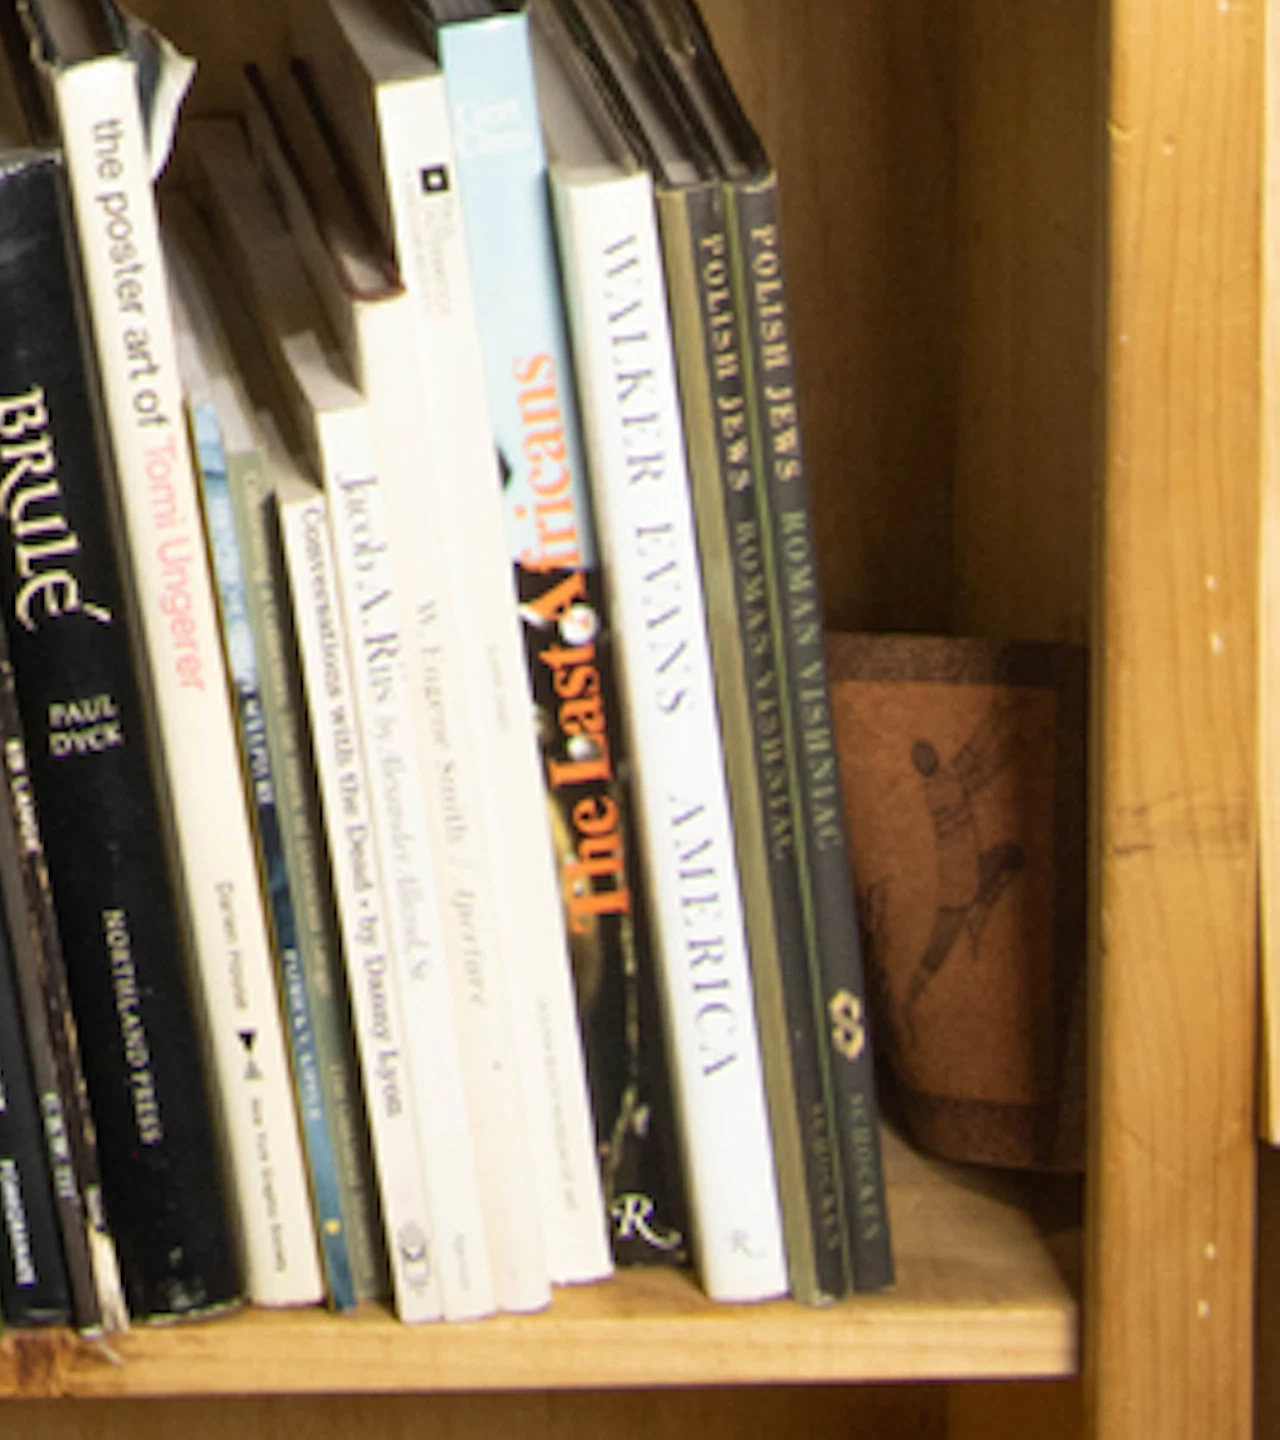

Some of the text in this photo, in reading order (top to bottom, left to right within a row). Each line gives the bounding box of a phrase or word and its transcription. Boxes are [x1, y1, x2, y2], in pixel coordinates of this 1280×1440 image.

[88, 116, 213, 692] the poster art of Tomi Ungerer
[599, 234, 739, 1081] WALKER EVANS AMERICA
[750, 223, 844, 851] POLISH JEWS ROMAN VISHNIAC
